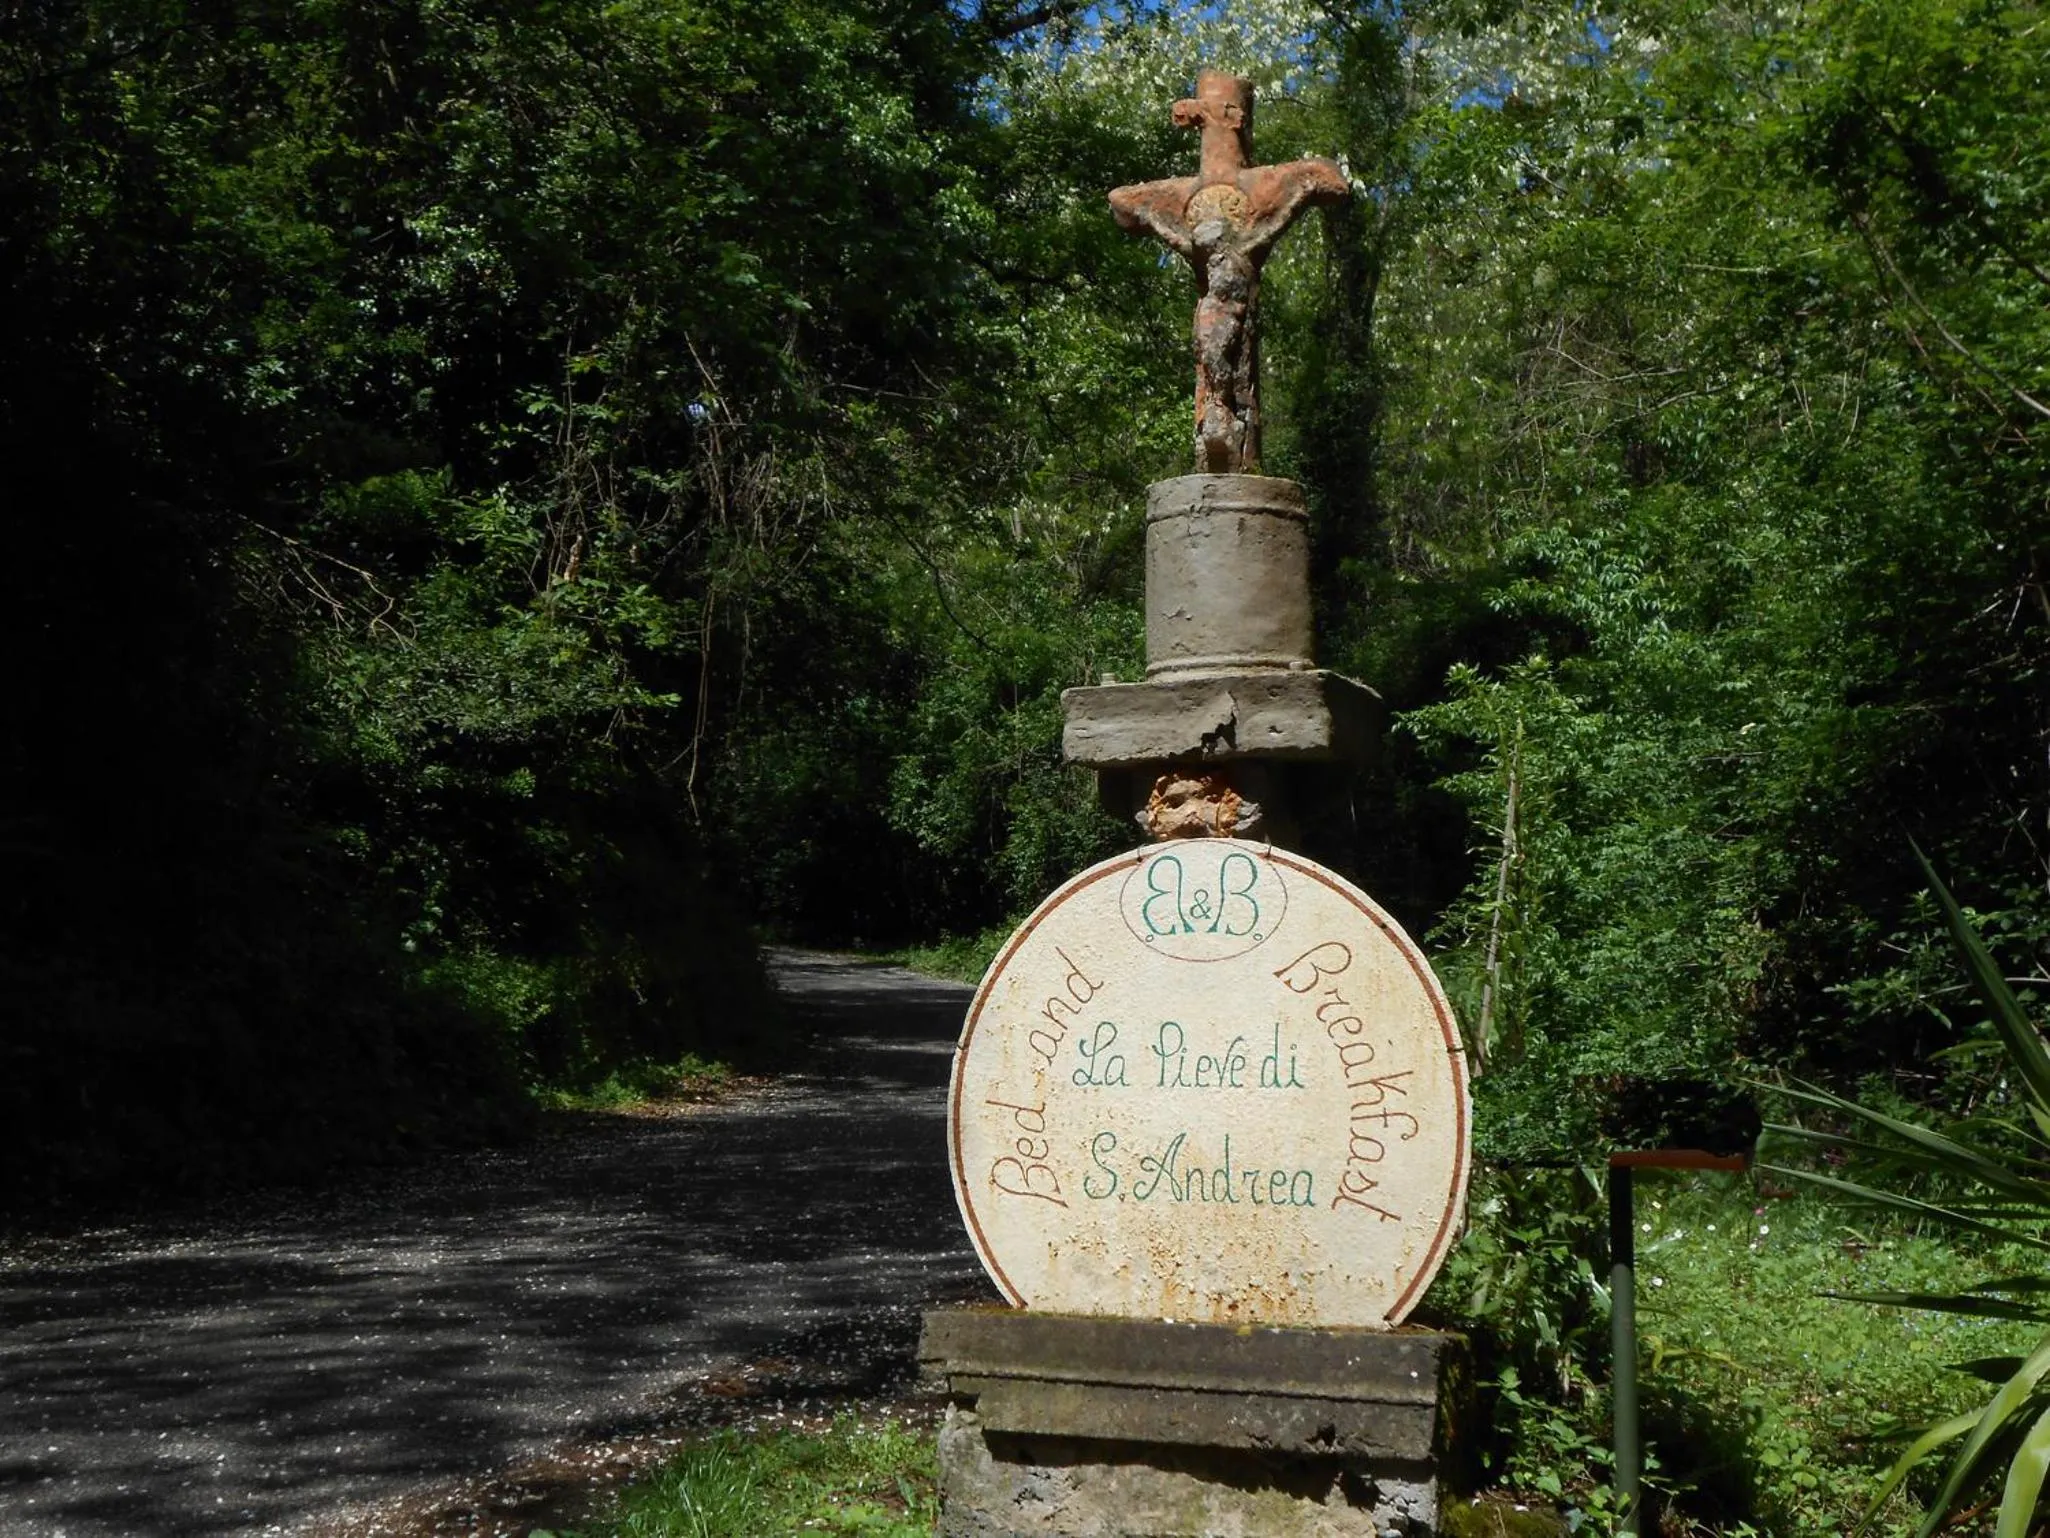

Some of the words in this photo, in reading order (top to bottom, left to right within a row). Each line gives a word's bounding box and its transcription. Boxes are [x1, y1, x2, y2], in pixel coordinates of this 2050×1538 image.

[985, 1100, 1069, 1208] Bed
[1029, 946, 1104, 1067] and
[1272, 941, 1419, 1223] Breakfast
[1072, 1021, 1130, 1087] La
[1259, 1022, 1305, 1089] di
